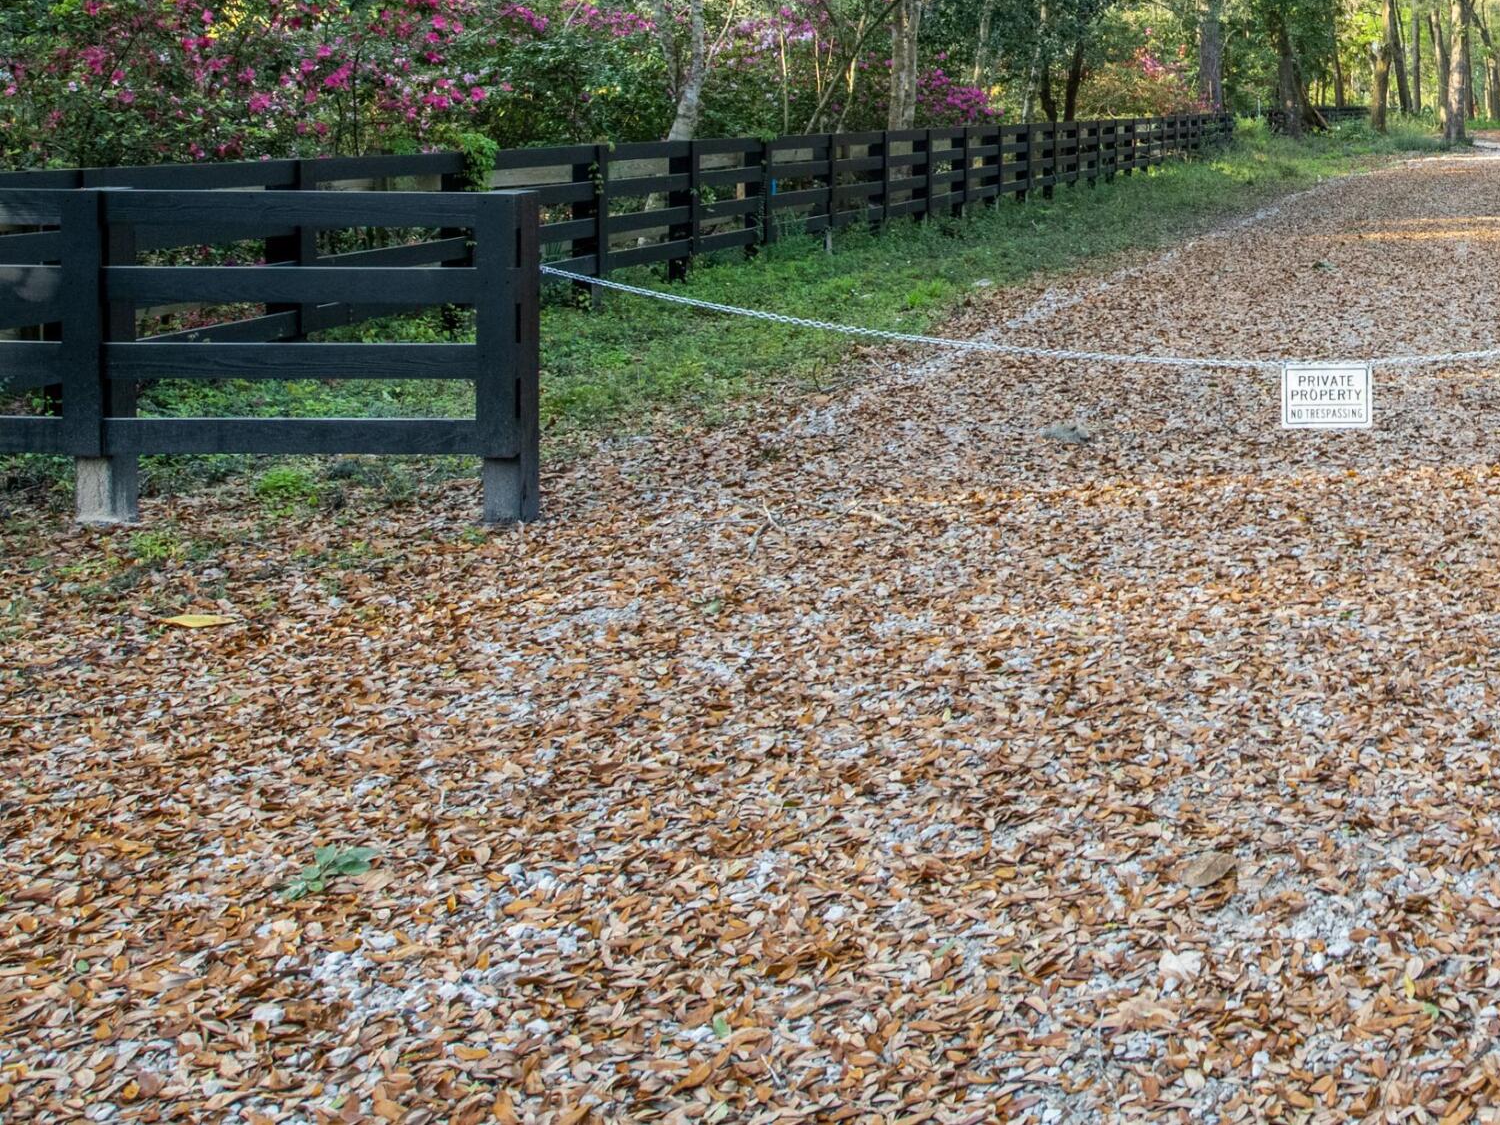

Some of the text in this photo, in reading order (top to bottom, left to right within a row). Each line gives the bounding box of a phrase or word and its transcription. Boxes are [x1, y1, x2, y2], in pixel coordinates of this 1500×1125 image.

[1298, 375, 1355, 387] PRIVATE
[1291, 389, 1362, 401] PROPERTY
[1291, 408, 1363, 420] NO TRESPASSING
